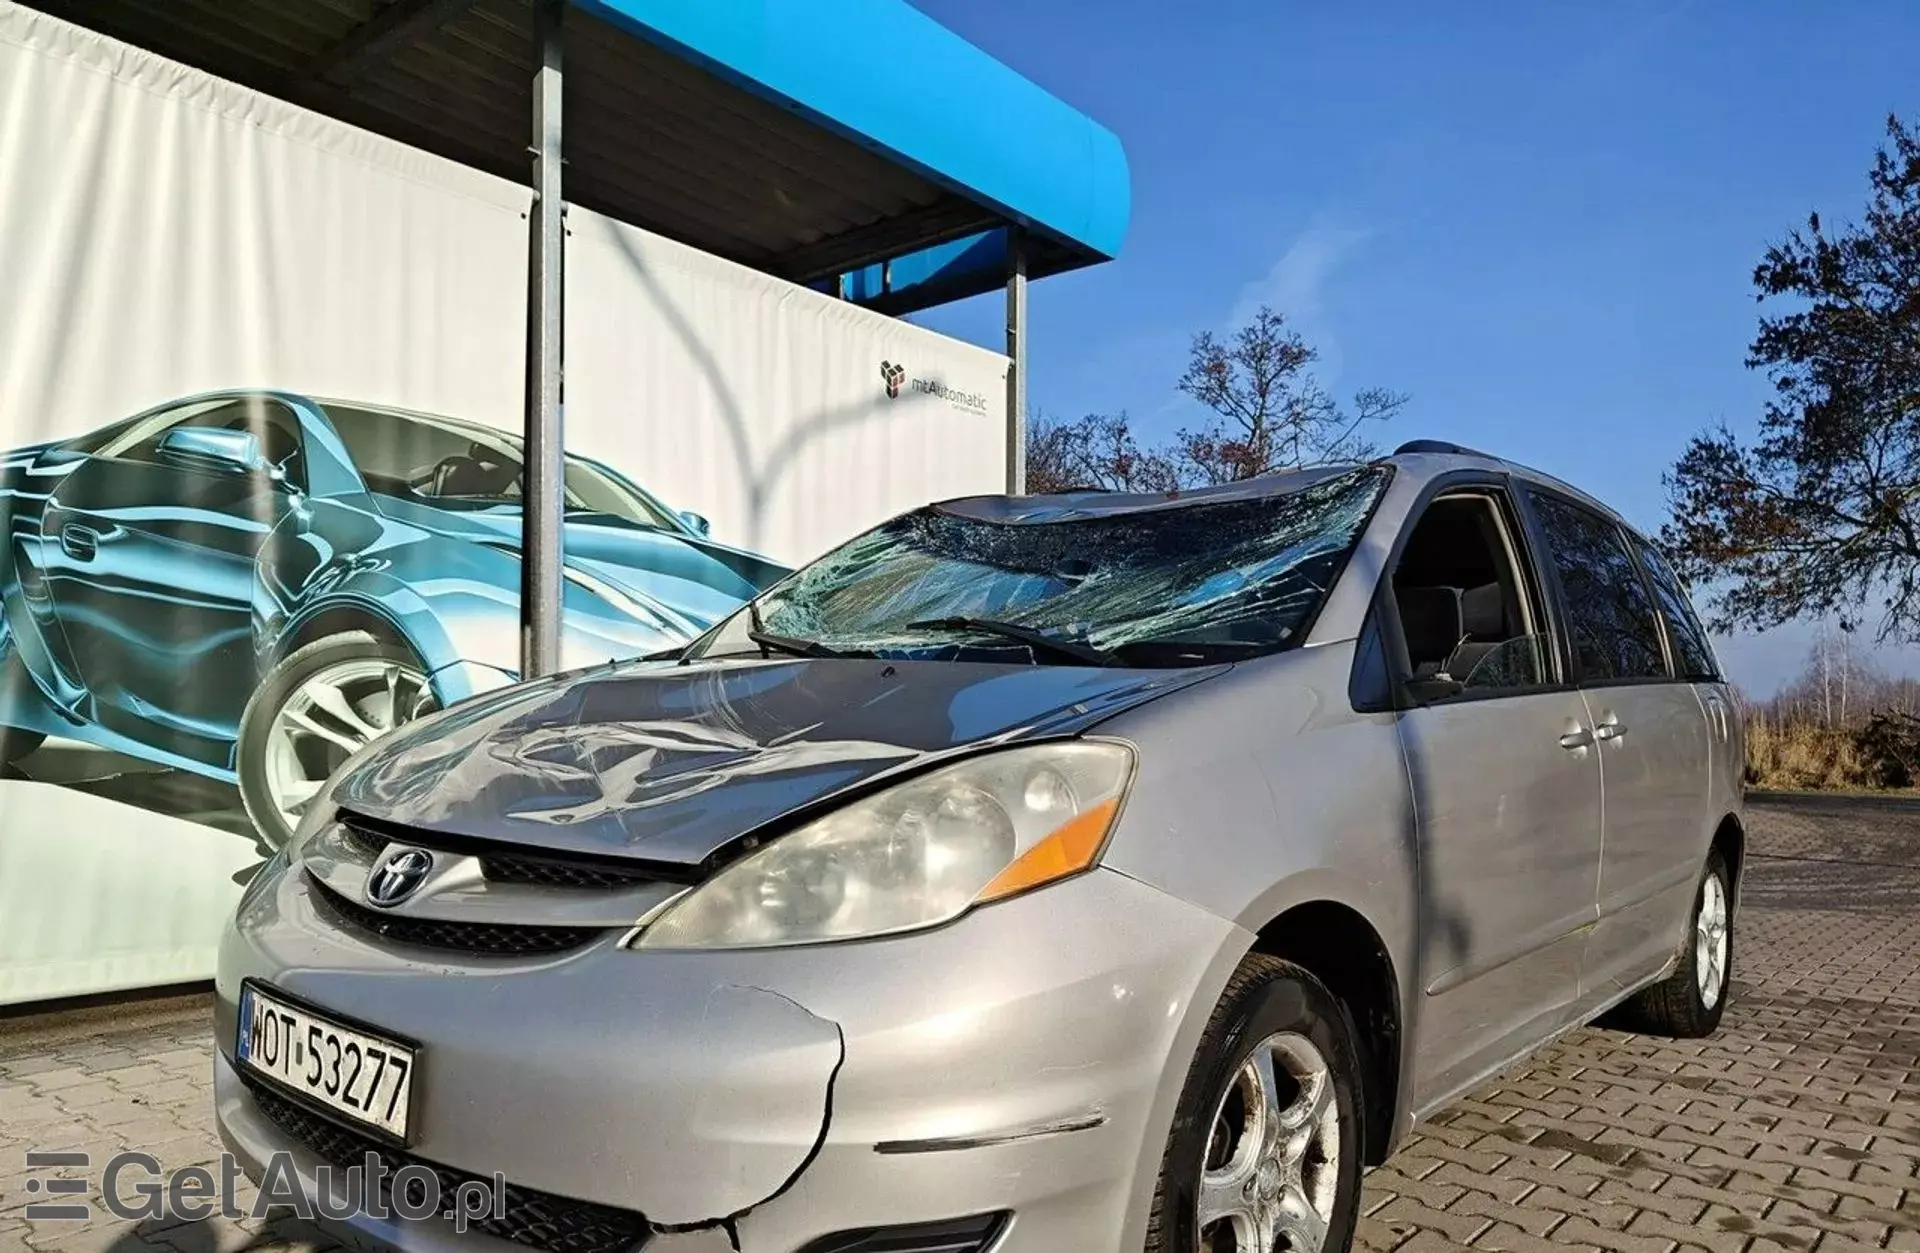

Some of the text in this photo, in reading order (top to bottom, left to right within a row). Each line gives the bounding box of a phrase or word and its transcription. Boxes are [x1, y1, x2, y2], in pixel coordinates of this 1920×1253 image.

[912, 378, 987, 411] mtAutomatic
[250, 1001, 408, 1122] WOT 53277
